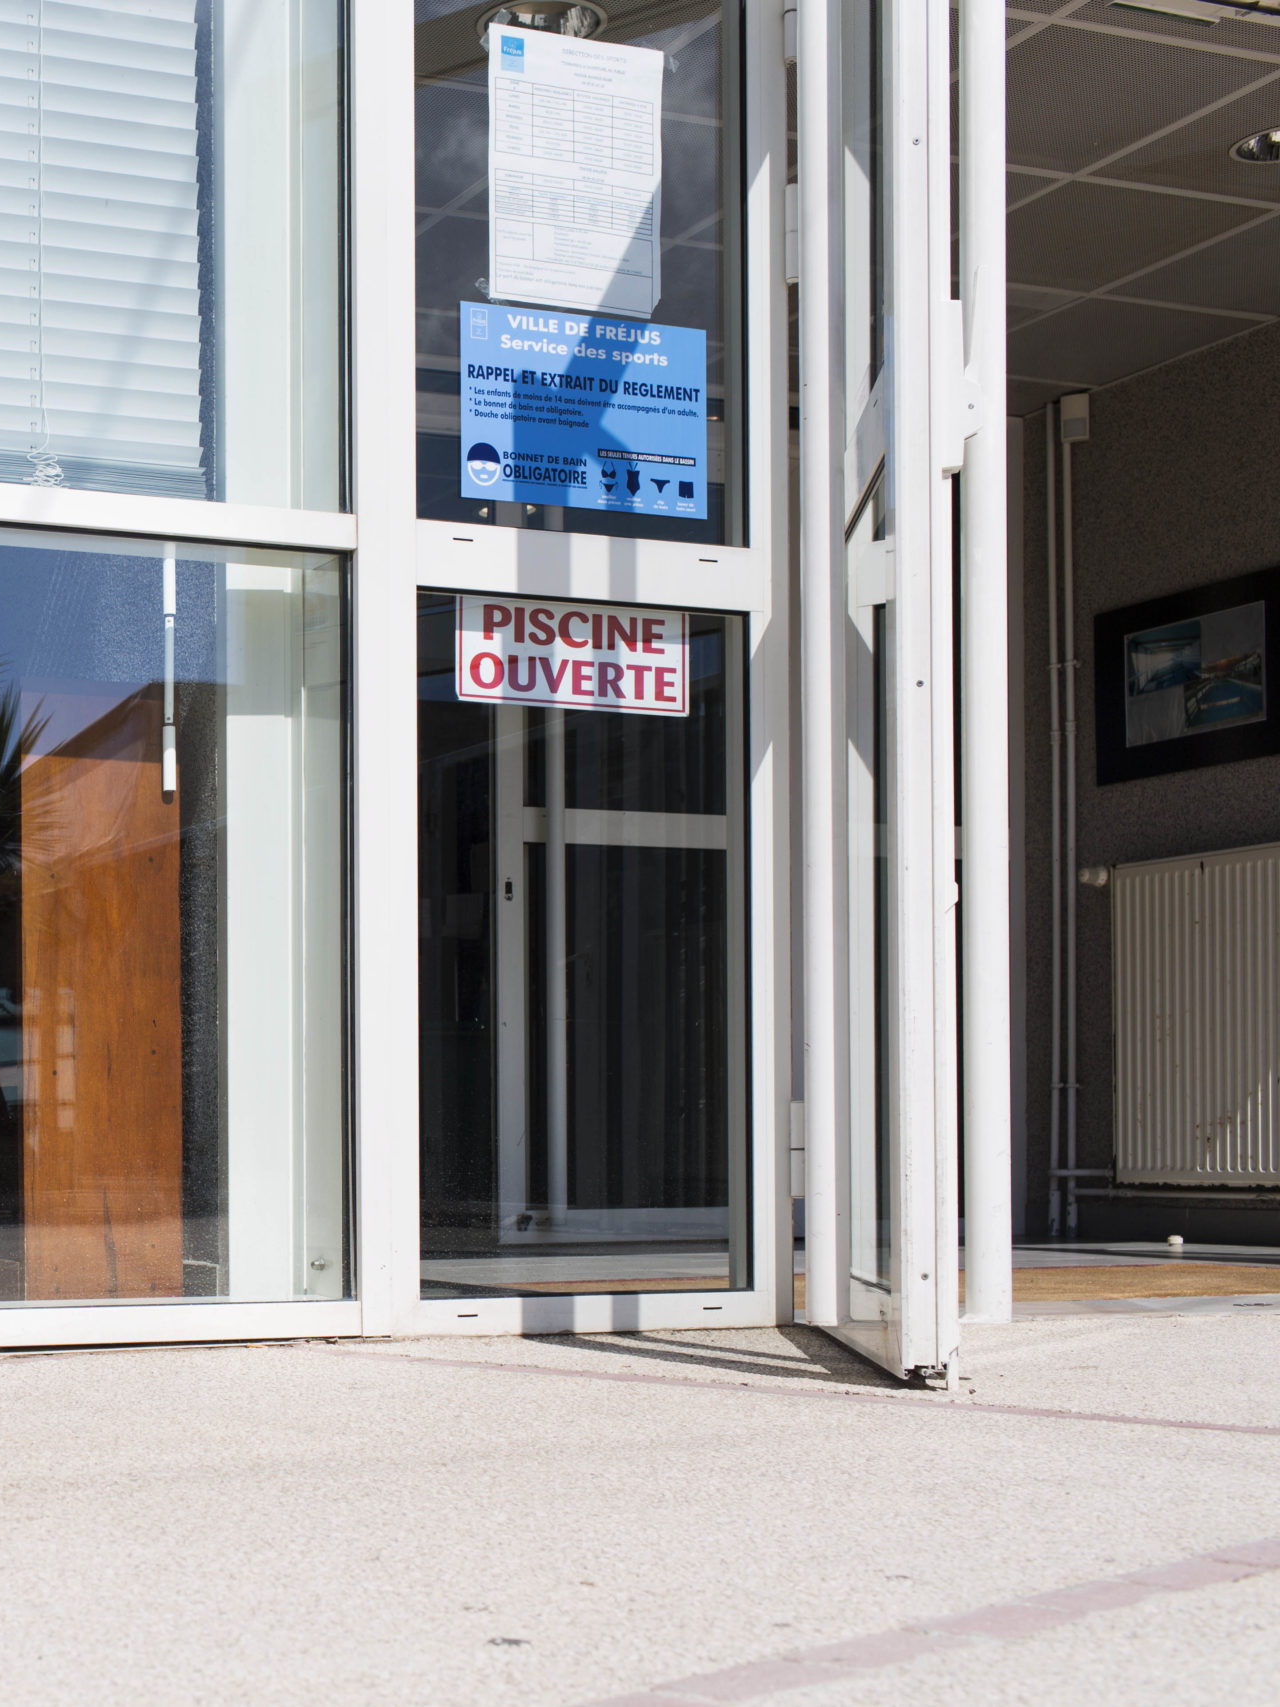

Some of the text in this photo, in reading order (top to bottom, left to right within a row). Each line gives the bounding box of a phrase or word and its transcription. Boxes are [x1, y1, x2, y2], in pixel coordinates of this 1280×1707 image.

[507, 314, 558, 334] VILLE
[564, 320, 589, 337] DE
[595, 324, 662, 345] FRÉJUS
[500, 334, 668, 366] Service des sports
[467, 364, 700, 403] RAPPEL ET EXTRAIT DU REGLEMENT
[474, 386, 485, 395] Les
[486, 388, 512, 398] enfants
[512, 390, 522, 399] de
[522, 392, 542, 402] moins
[544, 394, 552, 402] de
[577, 398, 600, 408] doivent
[602, 400, 616, 409] être
[617, 403, 660, 414] accompagnés
[662, 406, 676, 416] d'un
[677, 408, 699, 418] adulte.
[474, 398, 482, 406] Le
[484, 398, 506, 408] bonnet
[508, 400, 516, 409] de
[518, 402, 534, 412] bain
[546, 406, 584, 416] obligatoire.
[474, 408, 589, 428] Douche obligatoire avant baignade
[503, 451, 587, 467] BONNET DE BAIN
[503, 464, 587, 486] OBLIGATOIRE
[483, 604, 666, 654] PISCINE
[470, 652, 677, 702] OUVERTE
